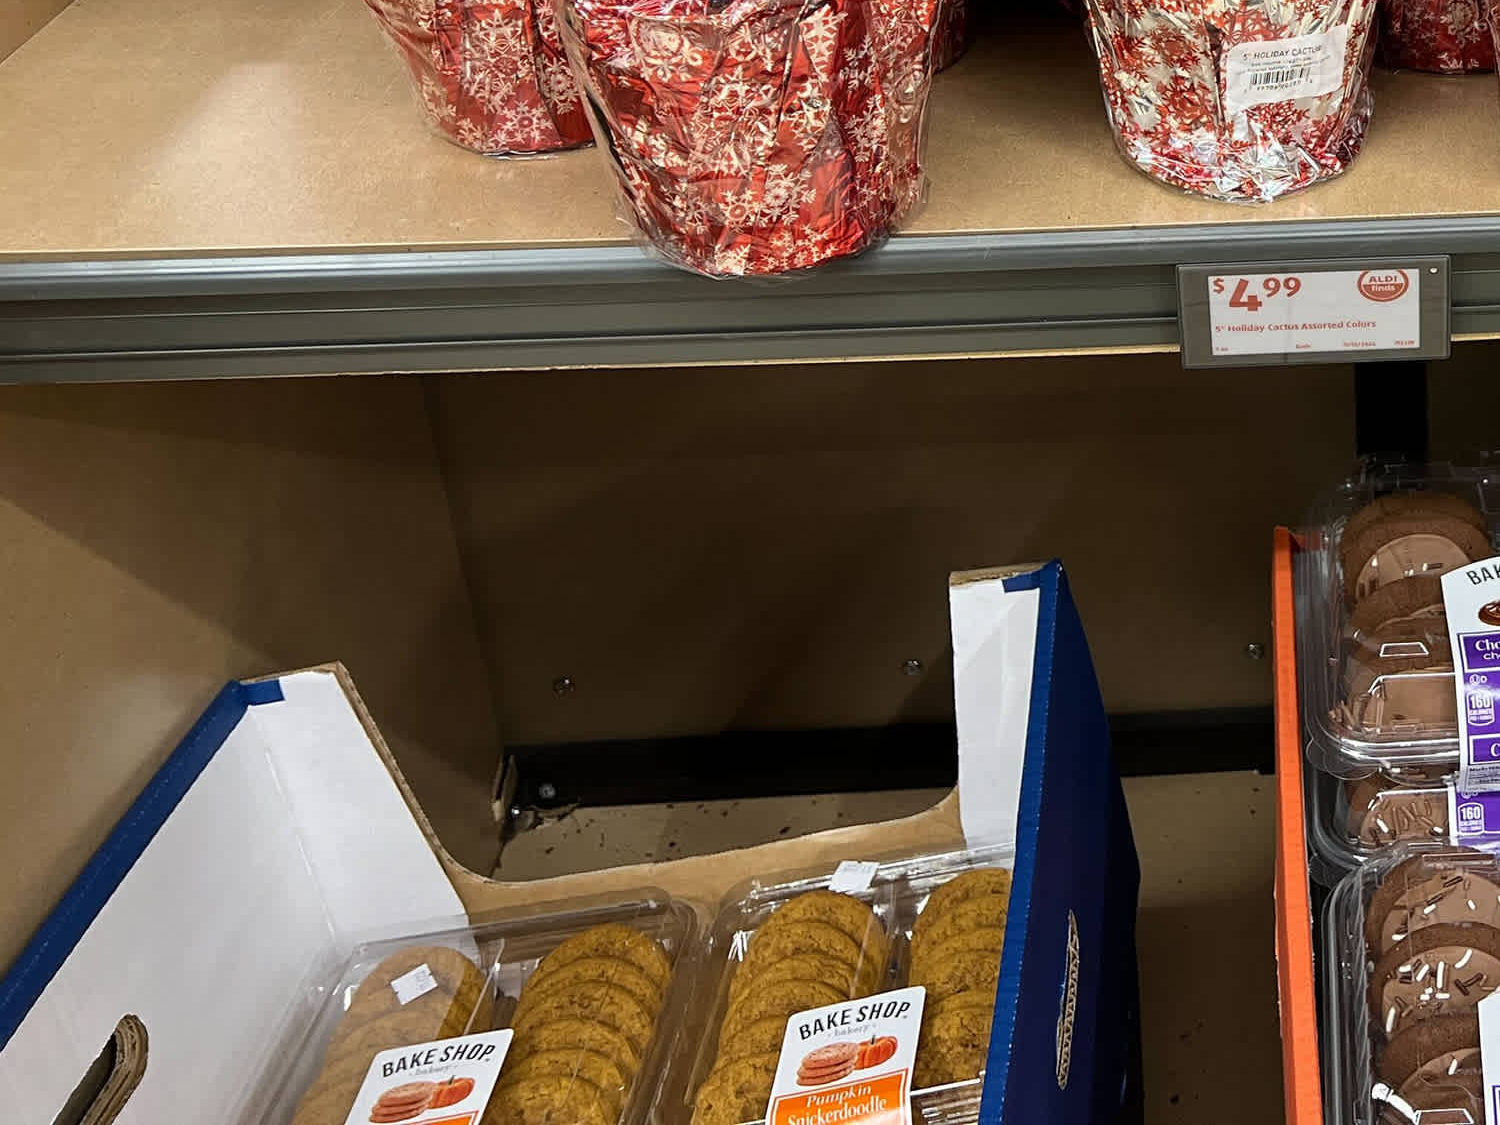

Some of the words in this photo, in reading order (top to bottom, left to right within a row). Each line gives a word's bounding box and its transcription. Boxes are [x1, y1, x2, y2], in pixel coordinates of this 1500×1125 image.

[1254, 49, 1289, 59] HOLIDAY
[1368, 274, 1398, 284] ALDI
[1371, 282, 1396, 292] finds
[1228, 323, 1265, 334] Holiday
[1268, 322, 1299, 332] Cactus
[1301, 321, 1344, 331] Assorted
[1346, 320, 1377, 329] Colors
[1469, 693, 1493, 709] 160
[1460, 807, 1481, 820] 160
[799, 1008, 852, 1041] BAKE
[856, 1001, 911, 1023] SHOP
[382, 1048, 438, 1078] BAKE
[439, 1043, 496, 1062] SHOP
[806, 1083, 872, 1108] Pumpkin
[787, 1095, 887, 1125] Snickerdoodle
